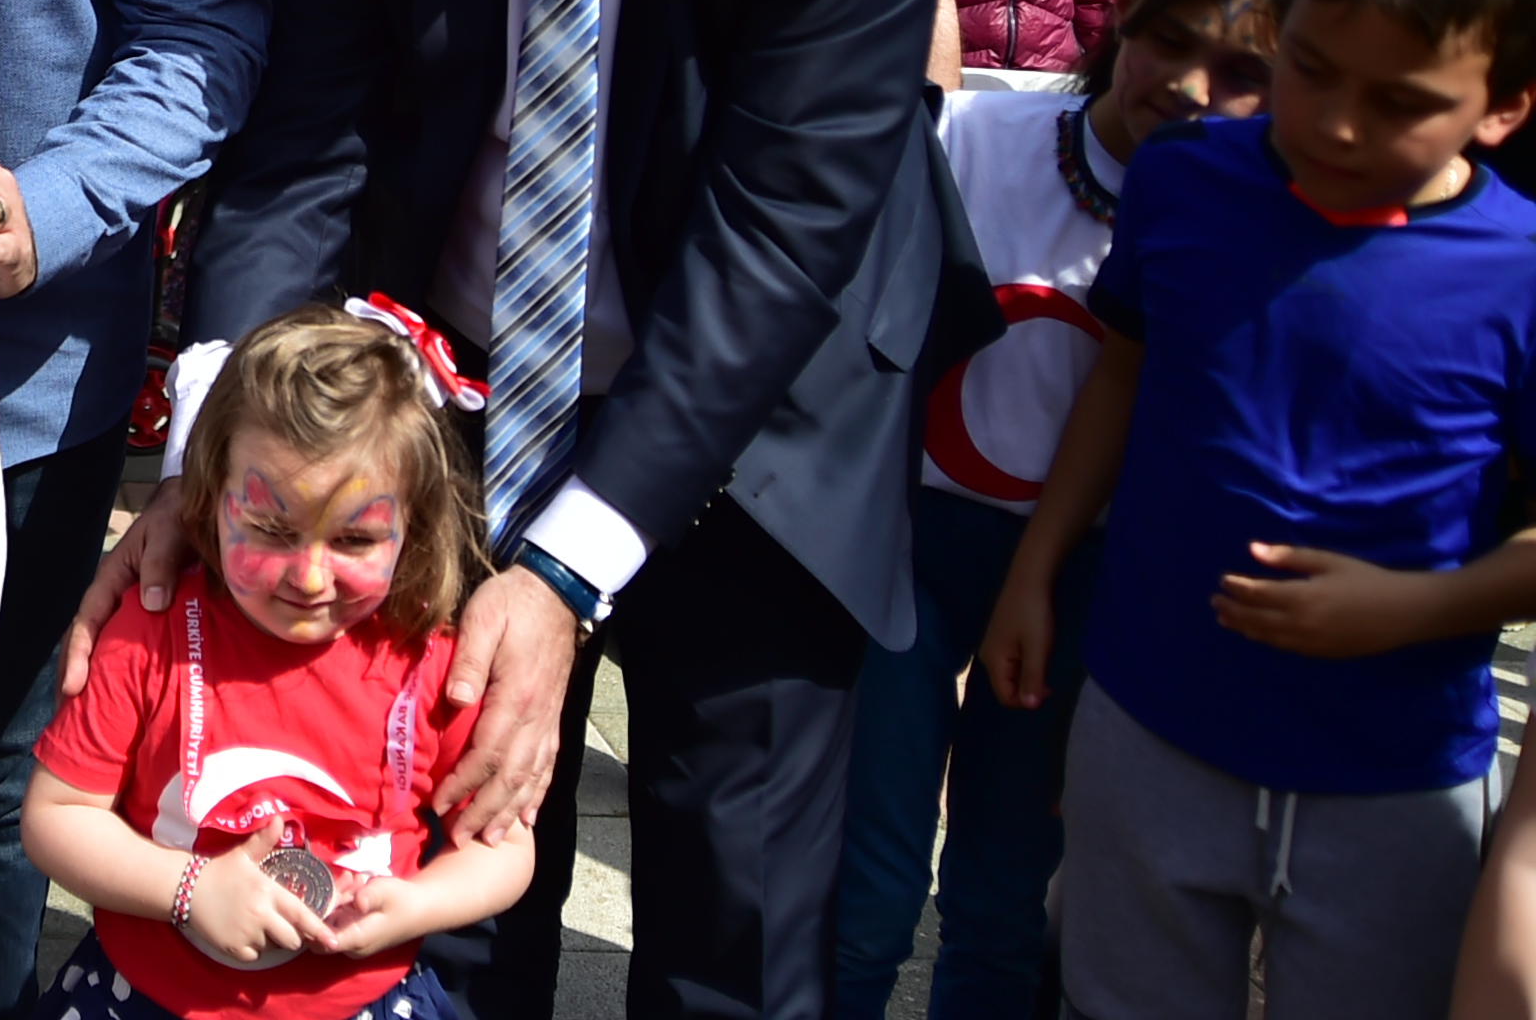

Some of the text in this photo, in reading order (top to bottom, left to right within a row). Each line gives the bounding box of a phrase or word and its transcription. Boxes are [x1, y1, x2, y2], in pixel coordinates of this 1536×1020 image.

[184, 598, 205, 661] TÜRKİYE
[186, 664, 205, 777] CUMHURİYETİ
[239, 800, 276, 829] SPOR
